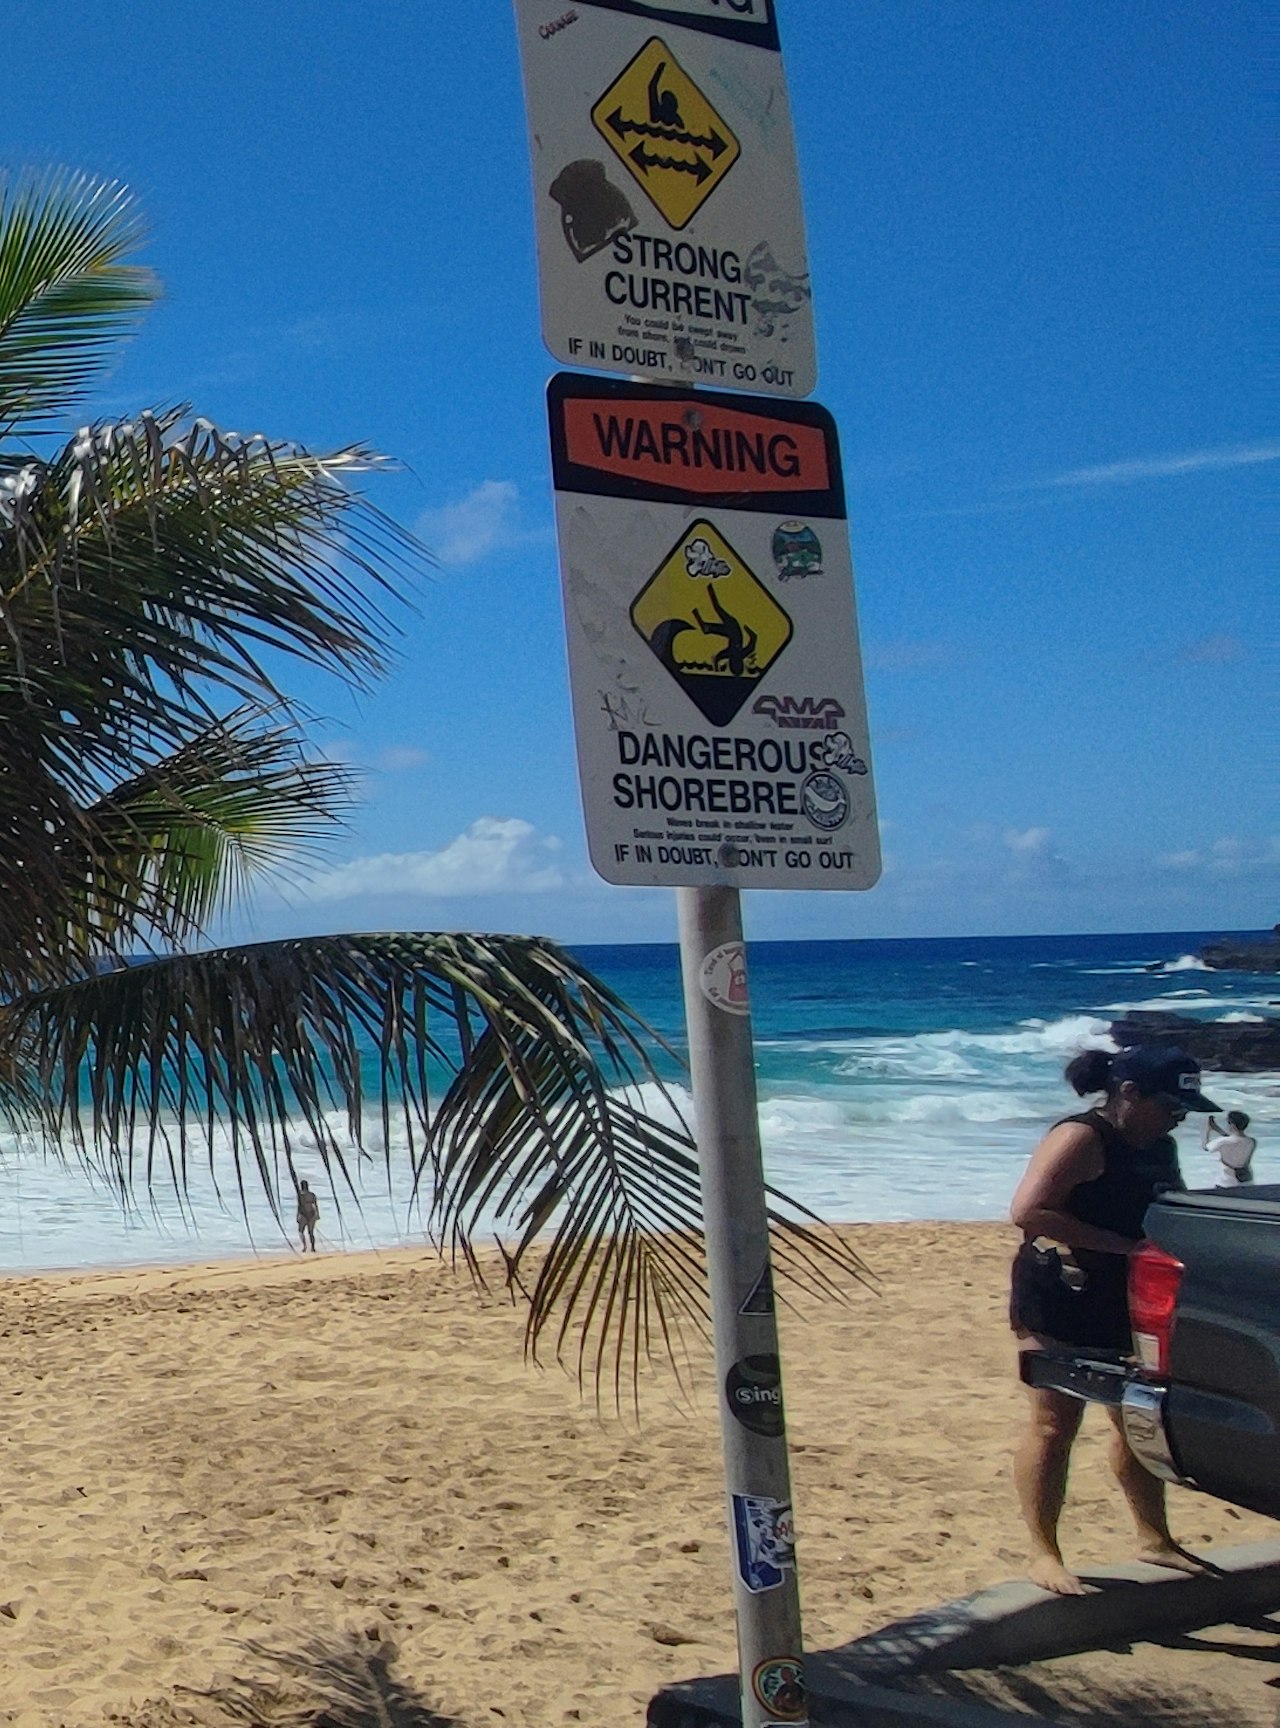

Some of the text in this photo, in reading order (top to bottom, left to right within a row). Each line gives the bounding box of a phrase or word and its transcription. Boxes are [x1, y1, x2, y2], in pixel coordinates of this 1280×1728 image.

[613, 231, 741, 283] STRONG
[605, 271, 751, 325] CURRENT
[569, 337, 583, 355] IF
[590, 341, 605, 359] IN
[733, 363, 756, 381] GO
[762, 365, 794, 387] OUT
[593, 412, 801, 477] WARNING
[618, 731, 830, 774] DANGEROUS
[615, 843, 854, 869] IF IN DOUBT, ON'T GO OUT
